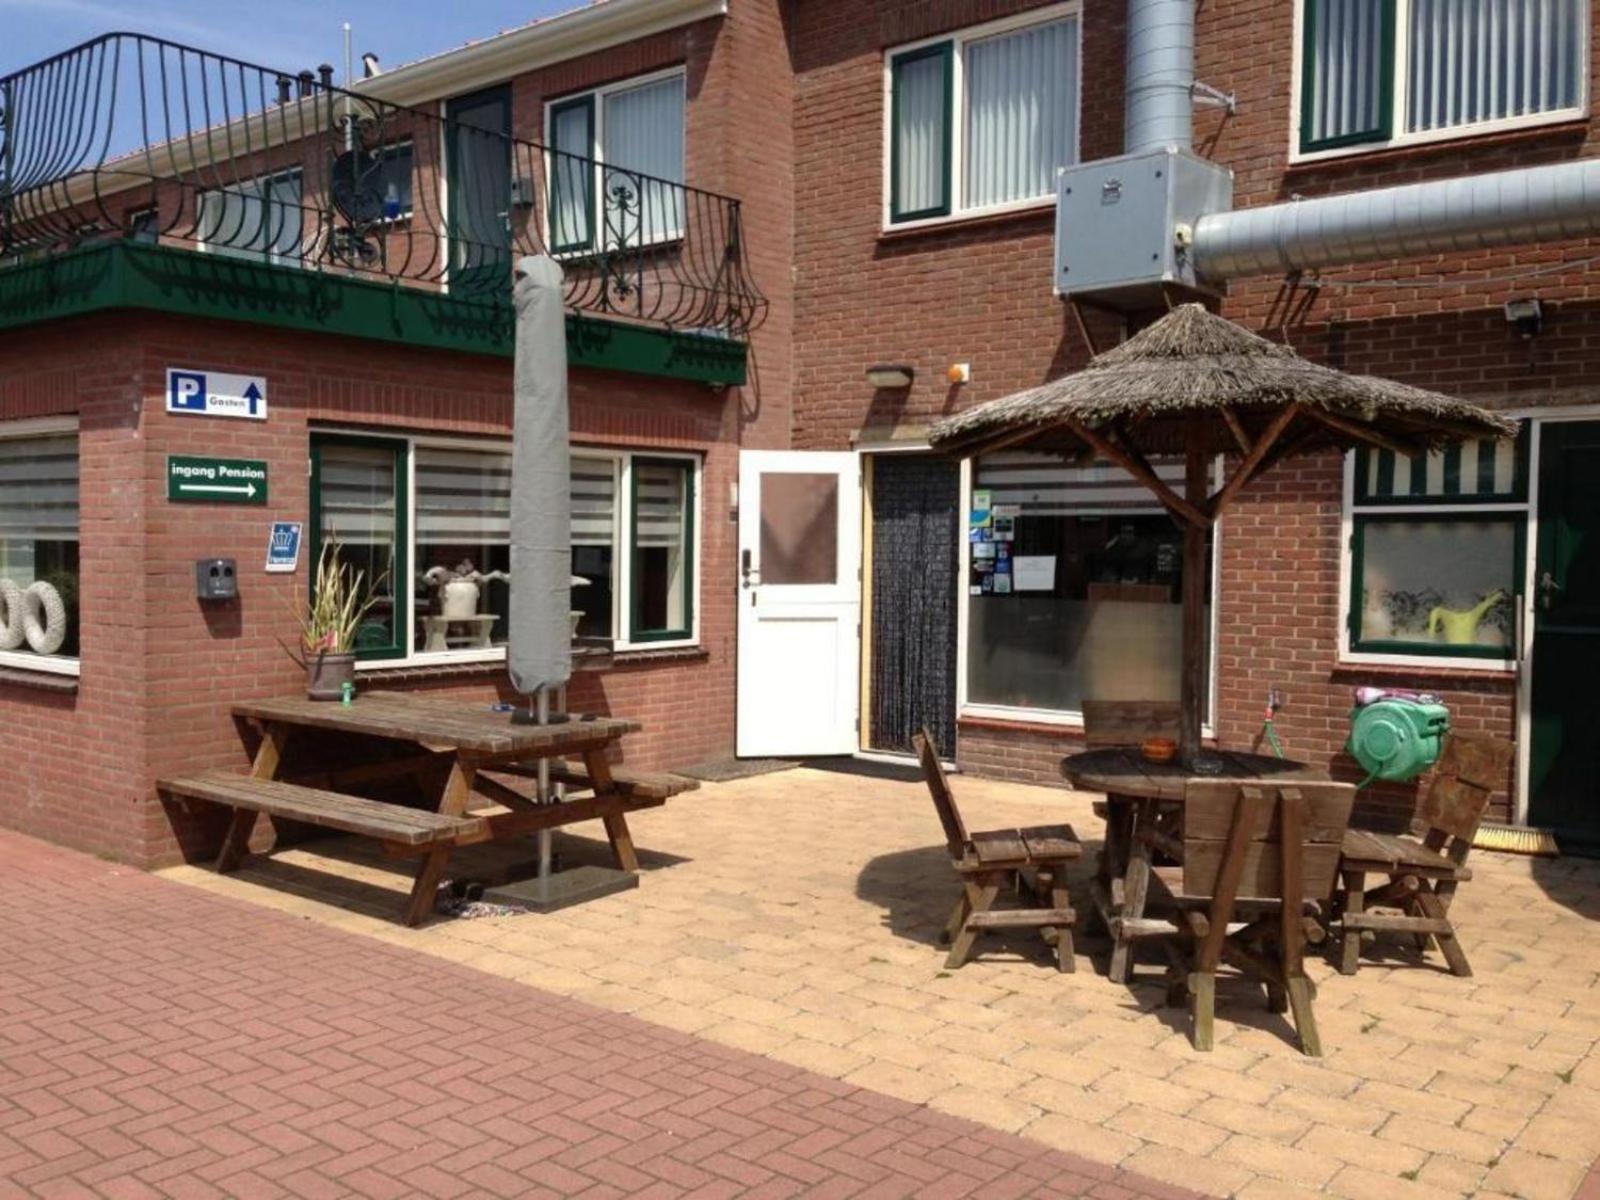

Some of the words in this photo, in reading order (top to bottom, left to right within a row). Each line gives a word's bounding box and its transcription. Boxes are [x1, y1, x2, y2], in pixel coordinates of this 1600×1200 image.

[178, 377, 199, 404] P
[209, 396, 245, 407] Gasten
[172, 463, 215, 479] ingang
[219, 466, 265, 479] Pension
